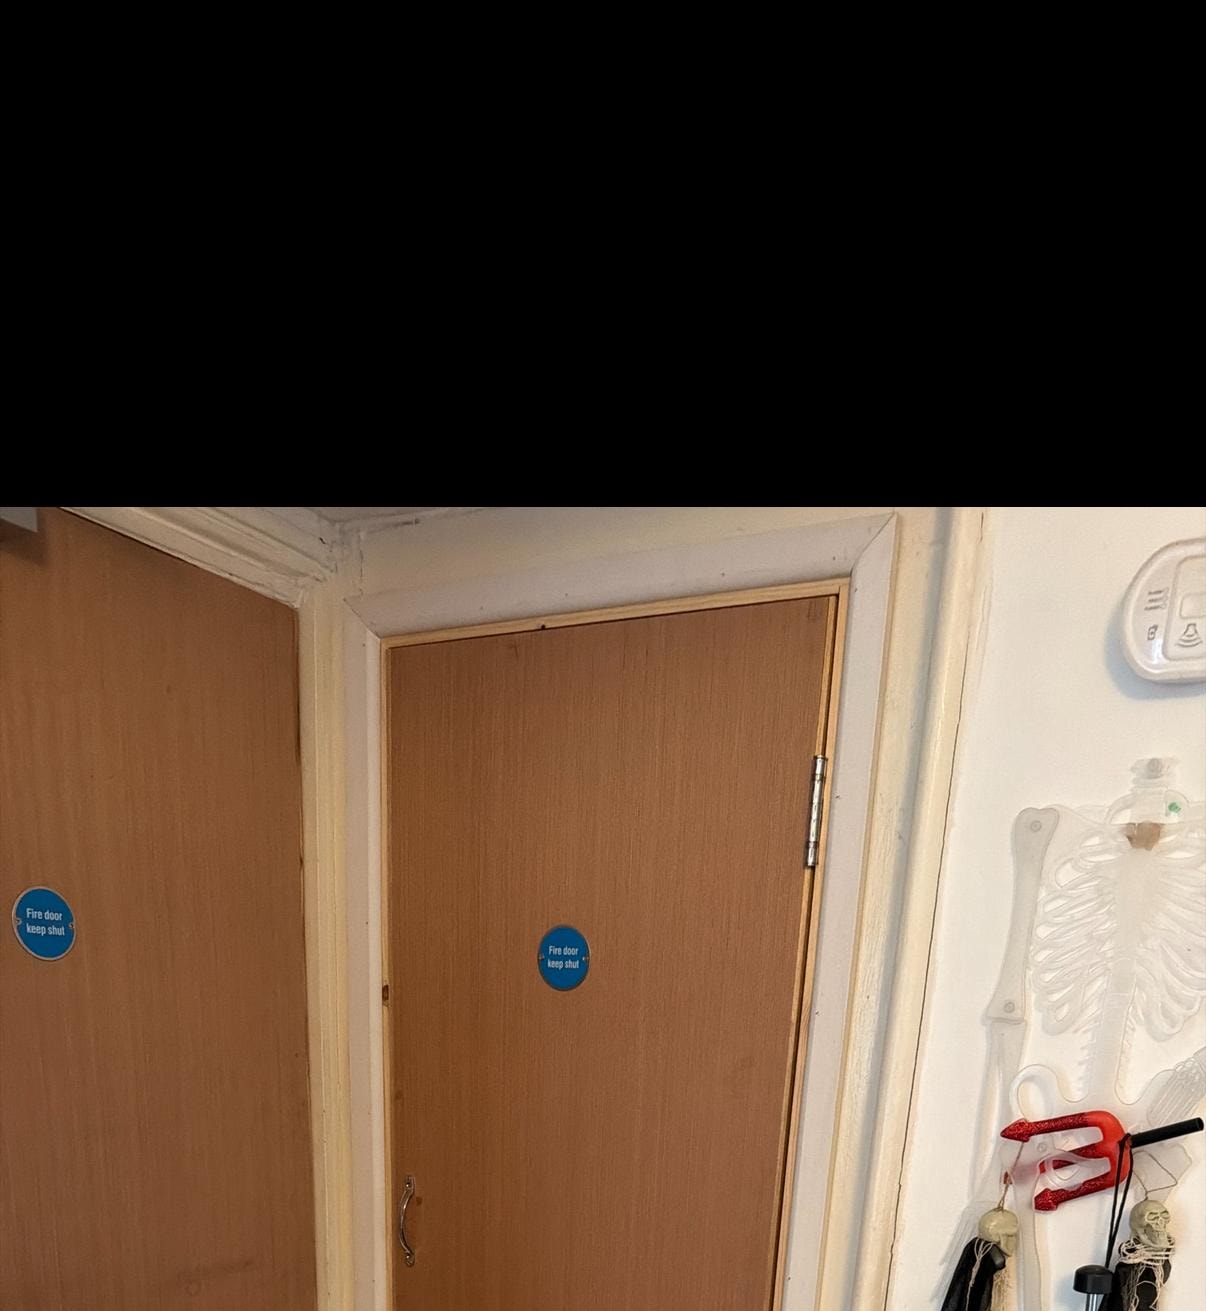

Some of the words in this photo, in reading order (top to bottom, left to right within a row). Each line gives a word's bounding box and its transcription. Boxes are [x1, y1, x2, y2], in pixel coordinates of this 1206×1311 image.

[26, 907, 43, 920] Fire
[44, 910, 62, 921] door
[26, 923, 46, 936] keep
[47, 925, 65, 936] shut
[548, 945, 562, 955] Fire
[563, 945, 578, 955] door
[547, 958, 563, 970] keep
[564, 959, 579, 969] shut
